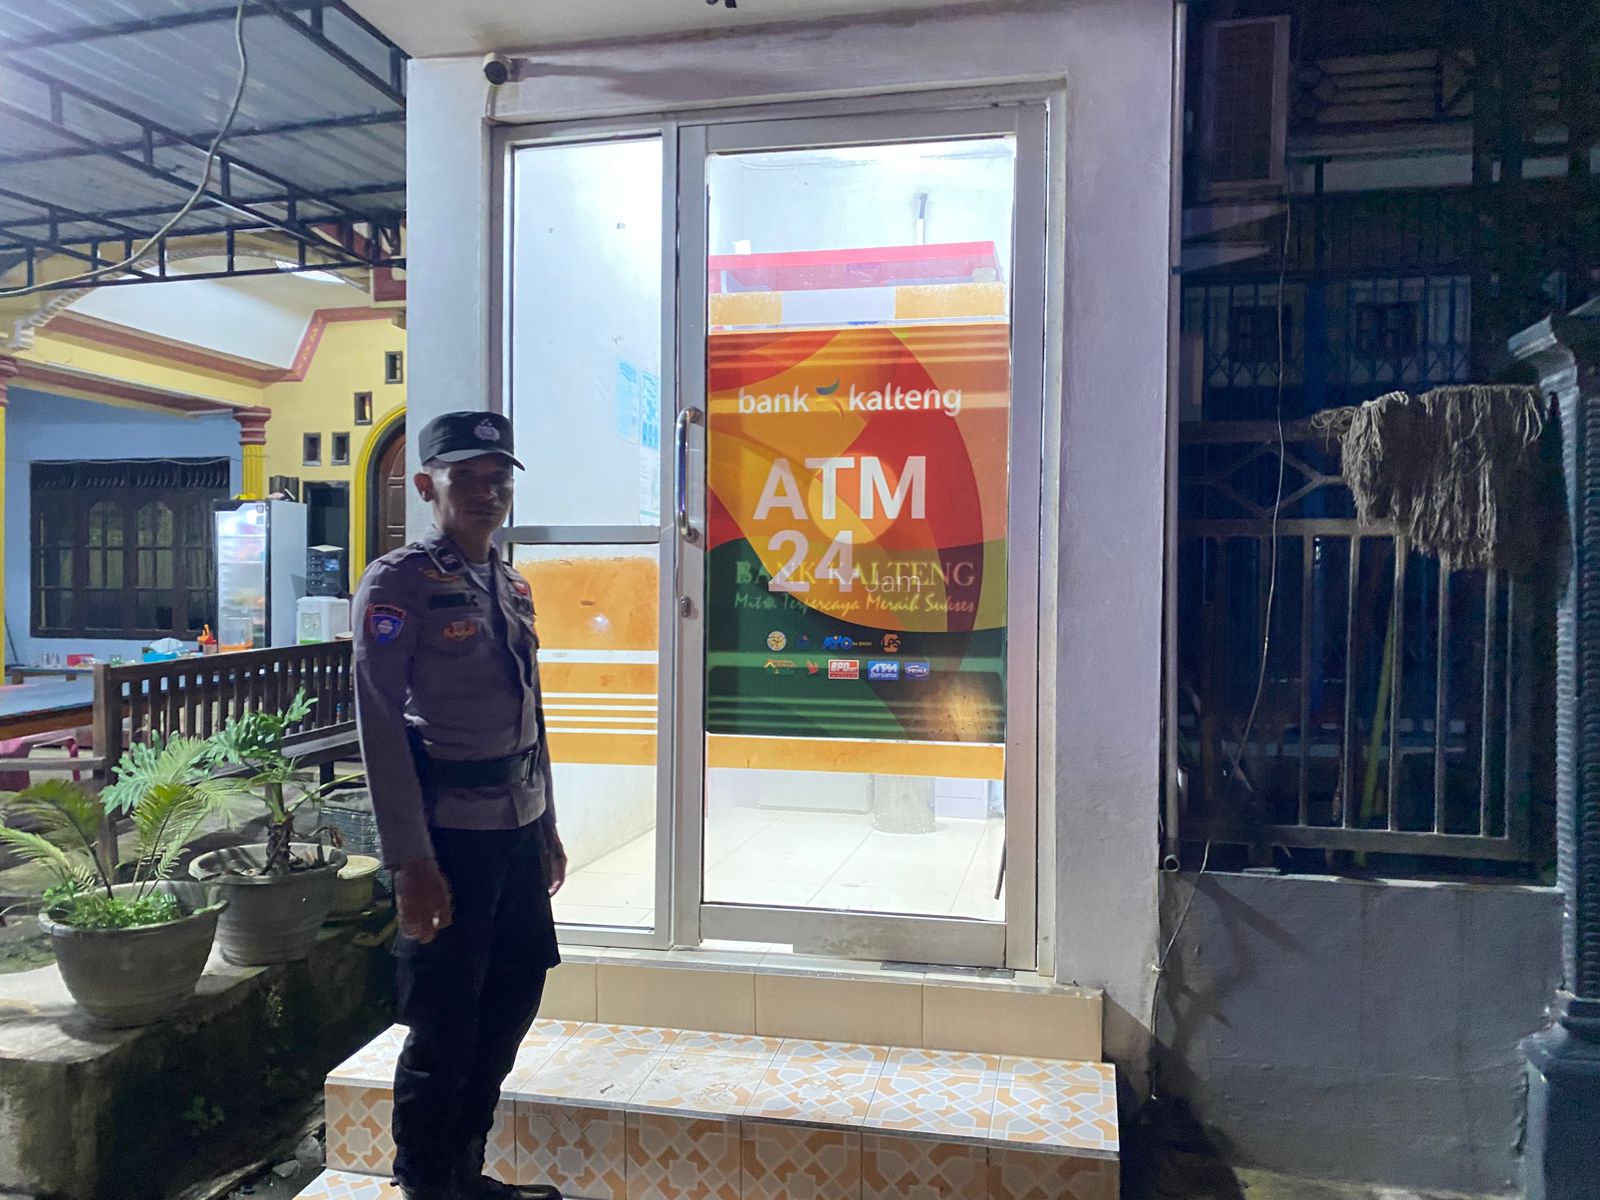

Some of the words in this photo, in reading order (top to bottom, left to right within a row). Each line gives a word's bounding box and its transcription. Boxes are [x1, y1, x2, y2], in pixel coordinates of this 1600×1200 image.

[738, 385, 809, 414] bank
[848, 382, 963, 417] kalteng
[752, 455, 927, 521] ATM
[767, 529, 859, 592] 24
[864, 570, 921, 593] Jam
[830, 661, 850, 672] BPD
[870, 662, 898, 673] ATM
